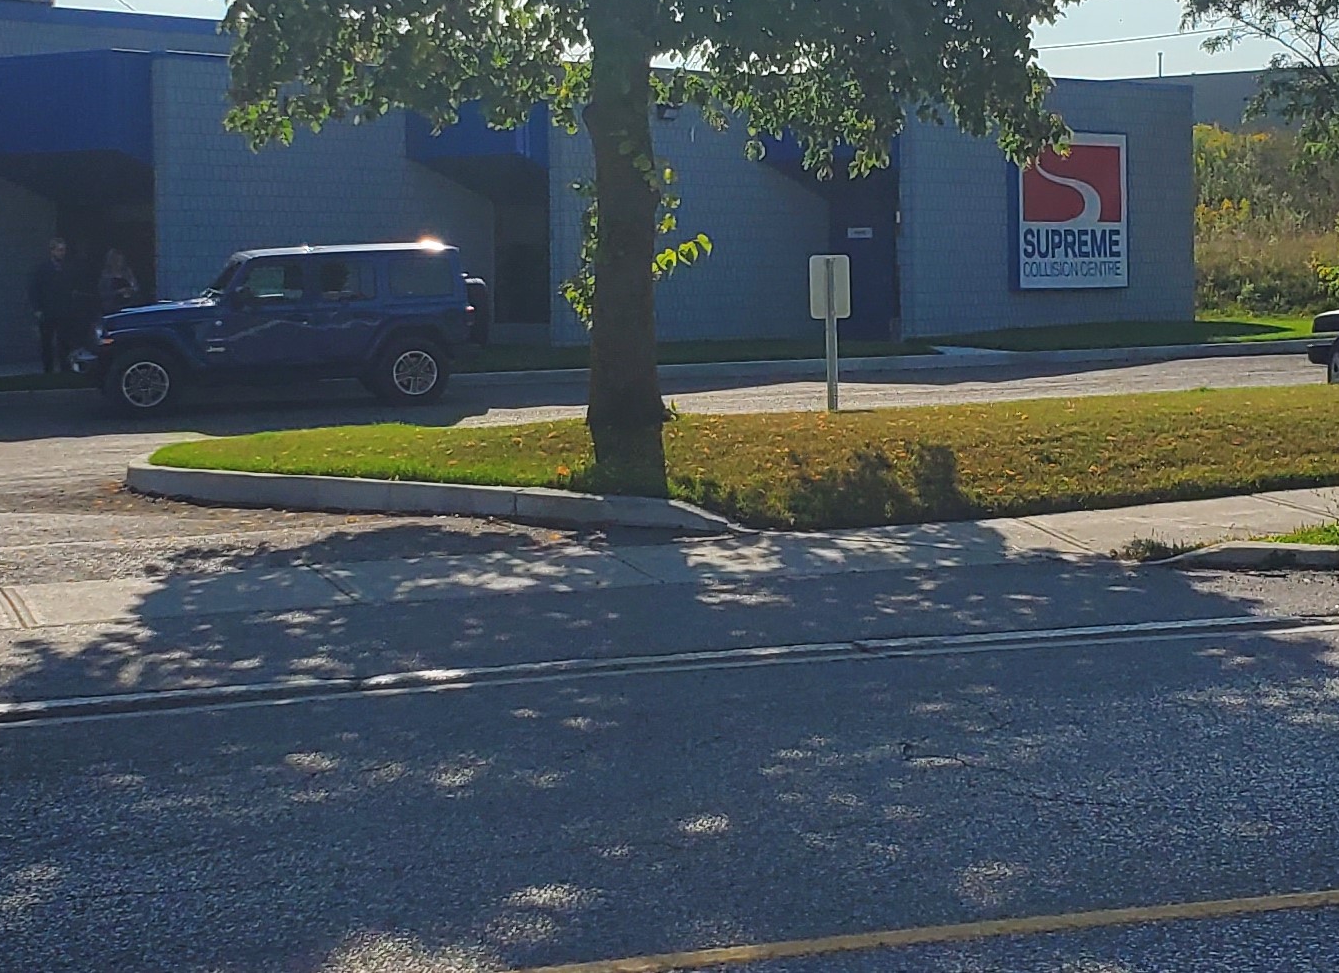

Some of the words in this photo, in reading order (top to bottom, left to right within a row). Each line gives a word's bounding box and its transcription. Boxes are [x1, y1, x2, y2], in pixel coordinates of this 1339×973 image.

[1023, 228, 1121, 258] SUPREME
[1023, 261, 1079, 277] COLLISION
[1080, 261, 1122, 277] CENTRE
